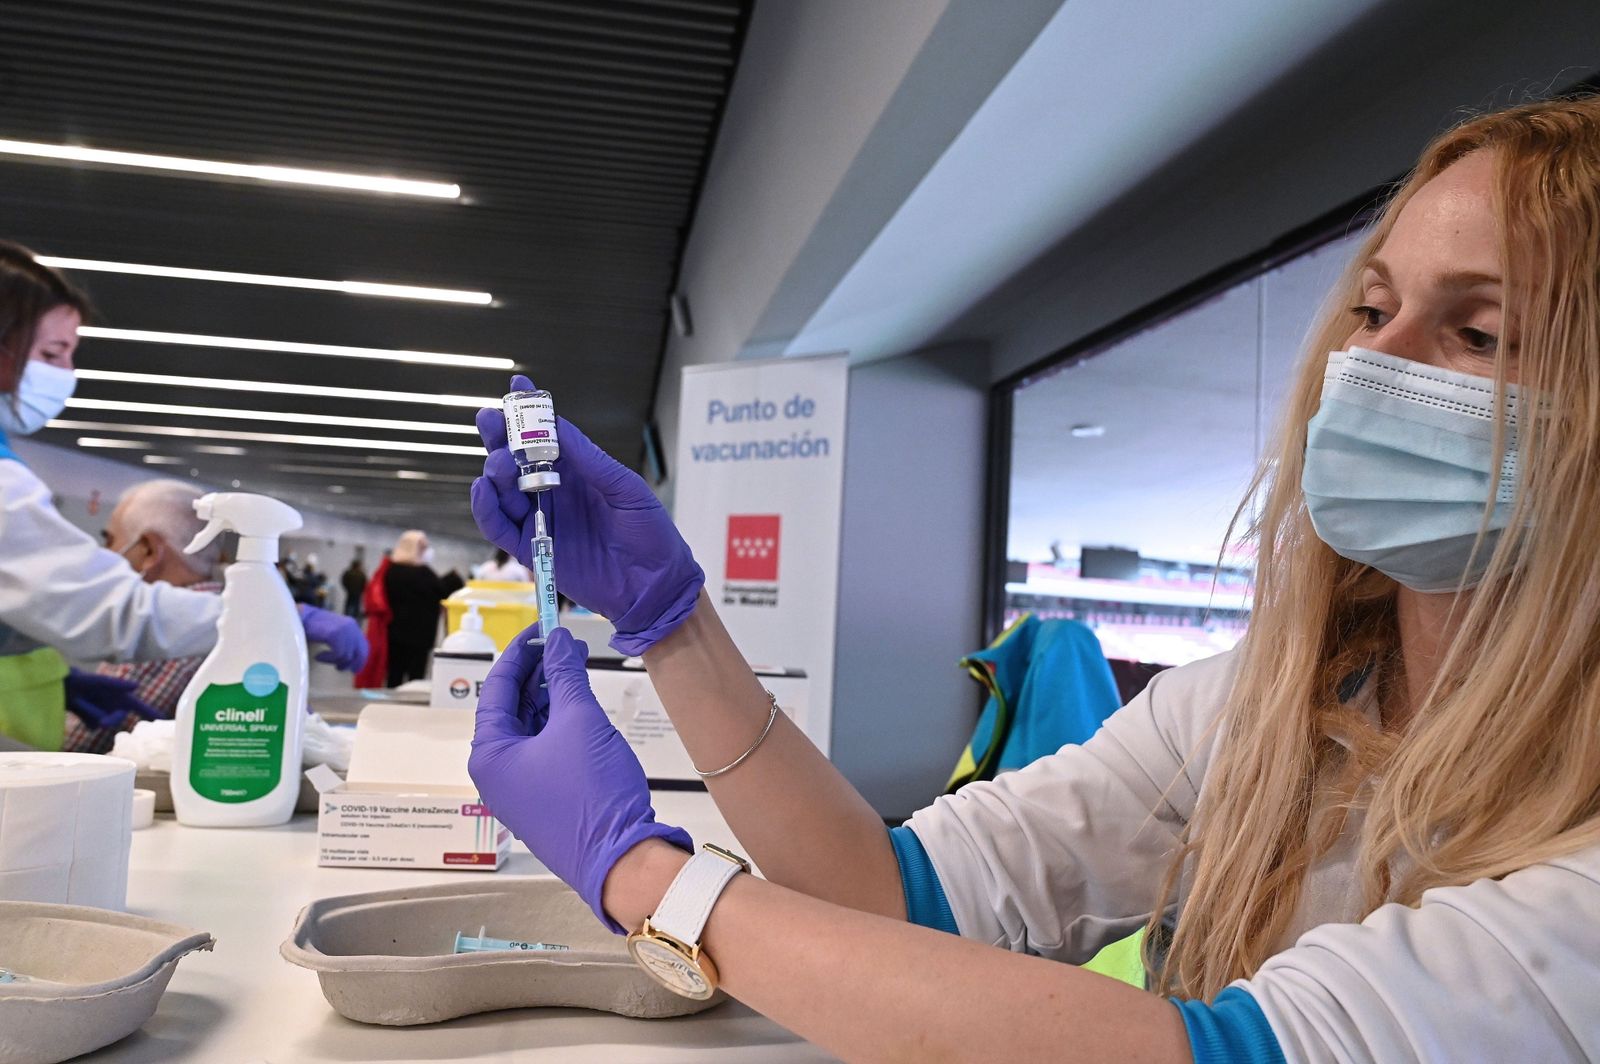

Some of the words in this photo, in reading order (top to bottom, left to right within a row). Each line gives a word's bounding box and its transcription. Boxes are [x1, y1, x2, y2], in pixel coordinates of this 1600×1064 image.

[707, 399, 778, 424] Punto
[784, 395, 816, 419] de
[691, 431, 830, 462] vacunación
[215, 708, 265, 722] clinell
[249, 724, 278, 732] SPRAY
[465, 806, 471, 814] 5
